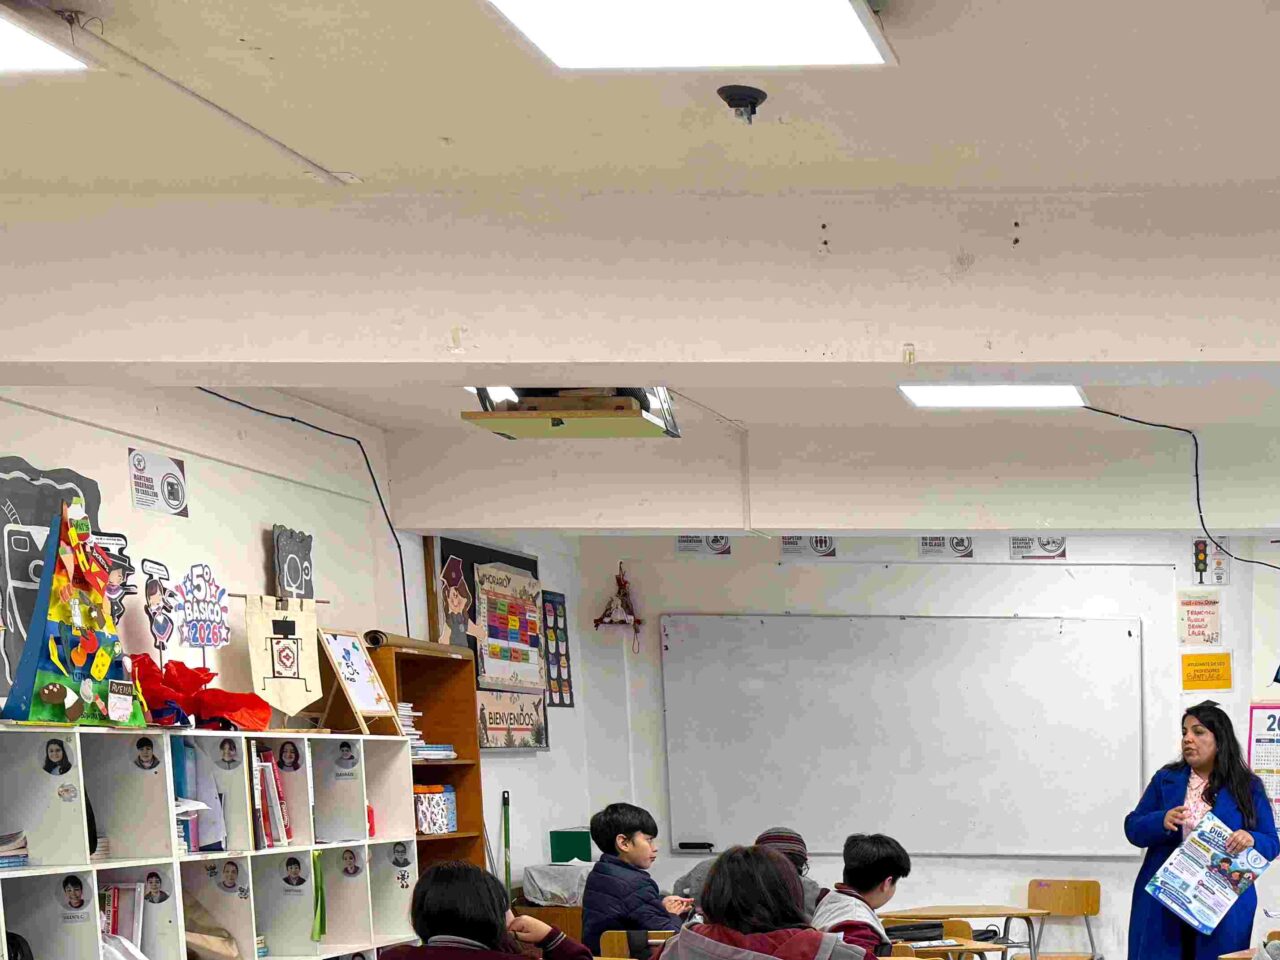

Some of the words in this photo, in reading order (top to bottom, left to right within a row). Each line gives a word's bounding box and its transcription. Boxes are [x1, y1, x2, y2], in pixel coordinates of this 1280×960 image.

[190, 621, 221, 644] 2026
[488, 711, 535, 727] BIENVENIDOS
[1209, 826, 1229, 841] DIBU
